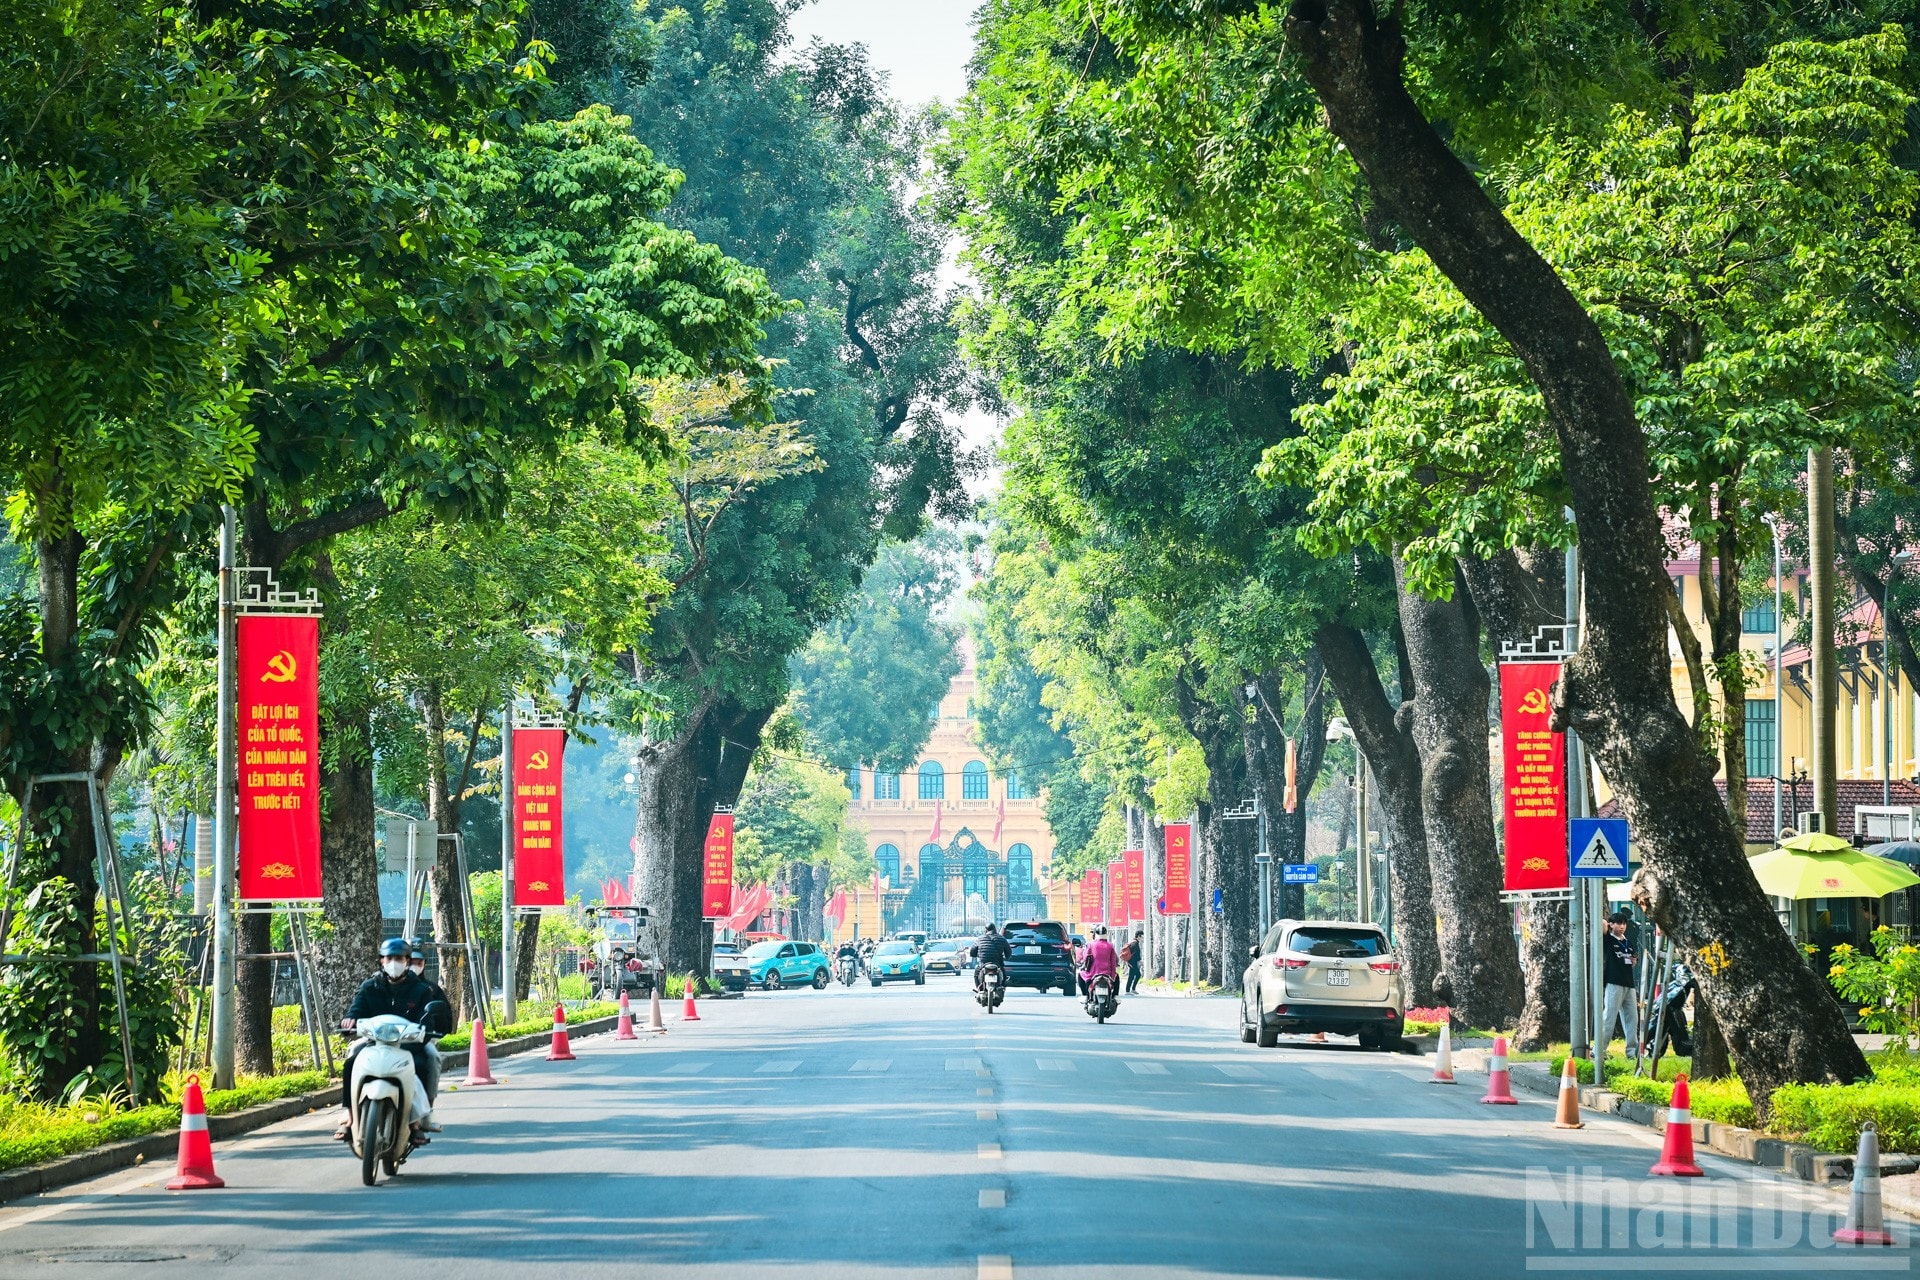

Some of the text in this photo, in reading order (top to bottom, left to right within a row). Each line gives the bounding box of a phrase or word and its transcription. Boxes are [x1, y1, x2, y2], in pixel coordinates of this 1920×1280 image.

[252, 703, 299, 722] ĐẶT LỢI ÍCH
[248, 724, 265, 742] CỦA
[279, 723, 304, 743] QUỐC,
[1517, 731, 1552, 740] TĂNG CƯỜNG
[1516, 741, 1532, 751] QUỐC
[246, 747, 307, 765] CỦA NHÂN DÂN
[1516, 764, 1524, 773] VÀ
[1537, 765, 1554, 774] MẠNH
[248, 769, 305, 788] LÊN TRÊN HẾT,
[1520, 774, 1531, 784] ĐỐI
[518, 782, 557, 798] ĐẢNG CỘNG SẢN
[1510, 785, 1559, 797] HỘI NHẬP QUỐC TẾ
[253, 792, 300, 809] TRƯỚC HẾT!
[1515, 797, 1523, 806] LÀ
[1524, 798, 1542, 807] TRỌNG
[525, 800, 548, 816] VIỆT NAM
[1514, 808, 1536, 817] THƯỜNG
[523, 820, 551, 832] QUANG VINH
[523, 835, 538, 849] MUÔN
[1332, 970, 1345, 978] 30G
